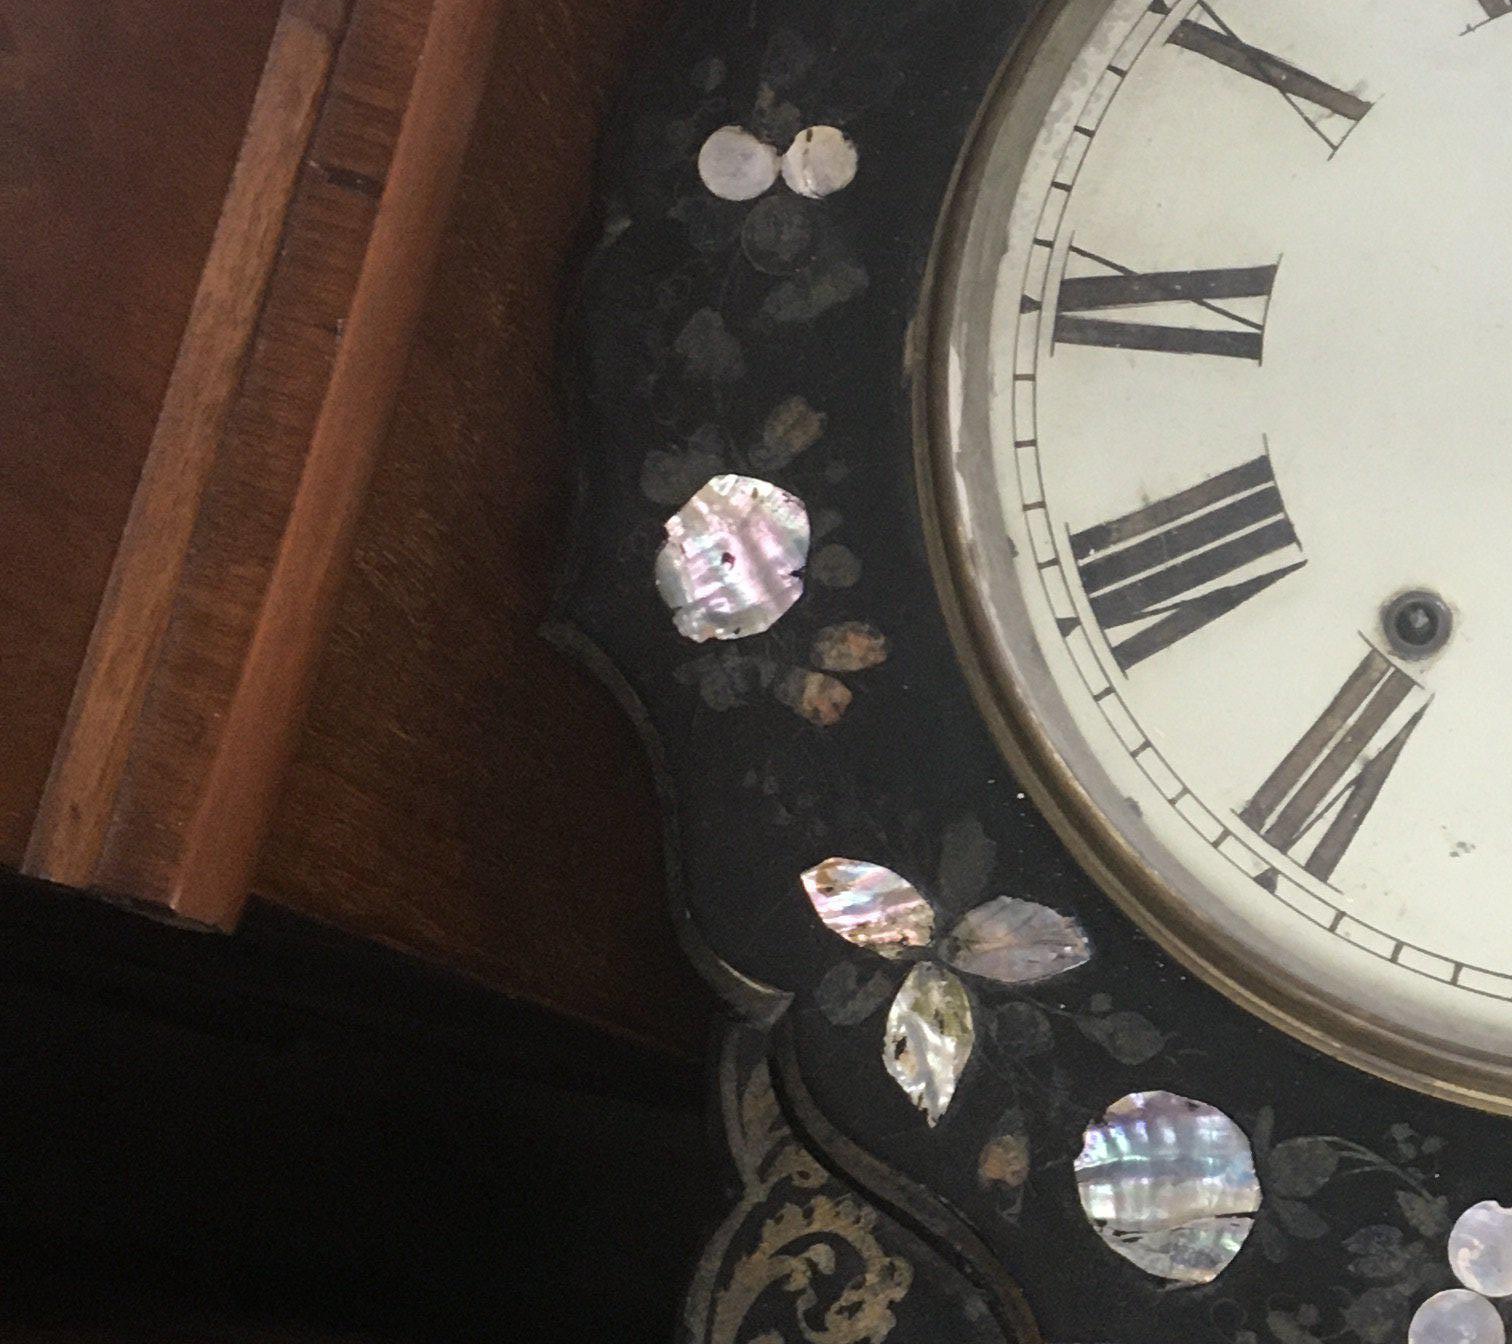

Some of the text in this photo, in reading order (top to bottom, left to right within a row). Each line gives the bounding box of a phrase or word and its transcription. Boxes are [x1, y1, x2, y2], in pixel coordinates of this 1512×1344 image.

[1050, 231, 1283, 366] IX
[1066, 433, 1309, 675] VIII
[1227, 631, 1435, 891] VII
